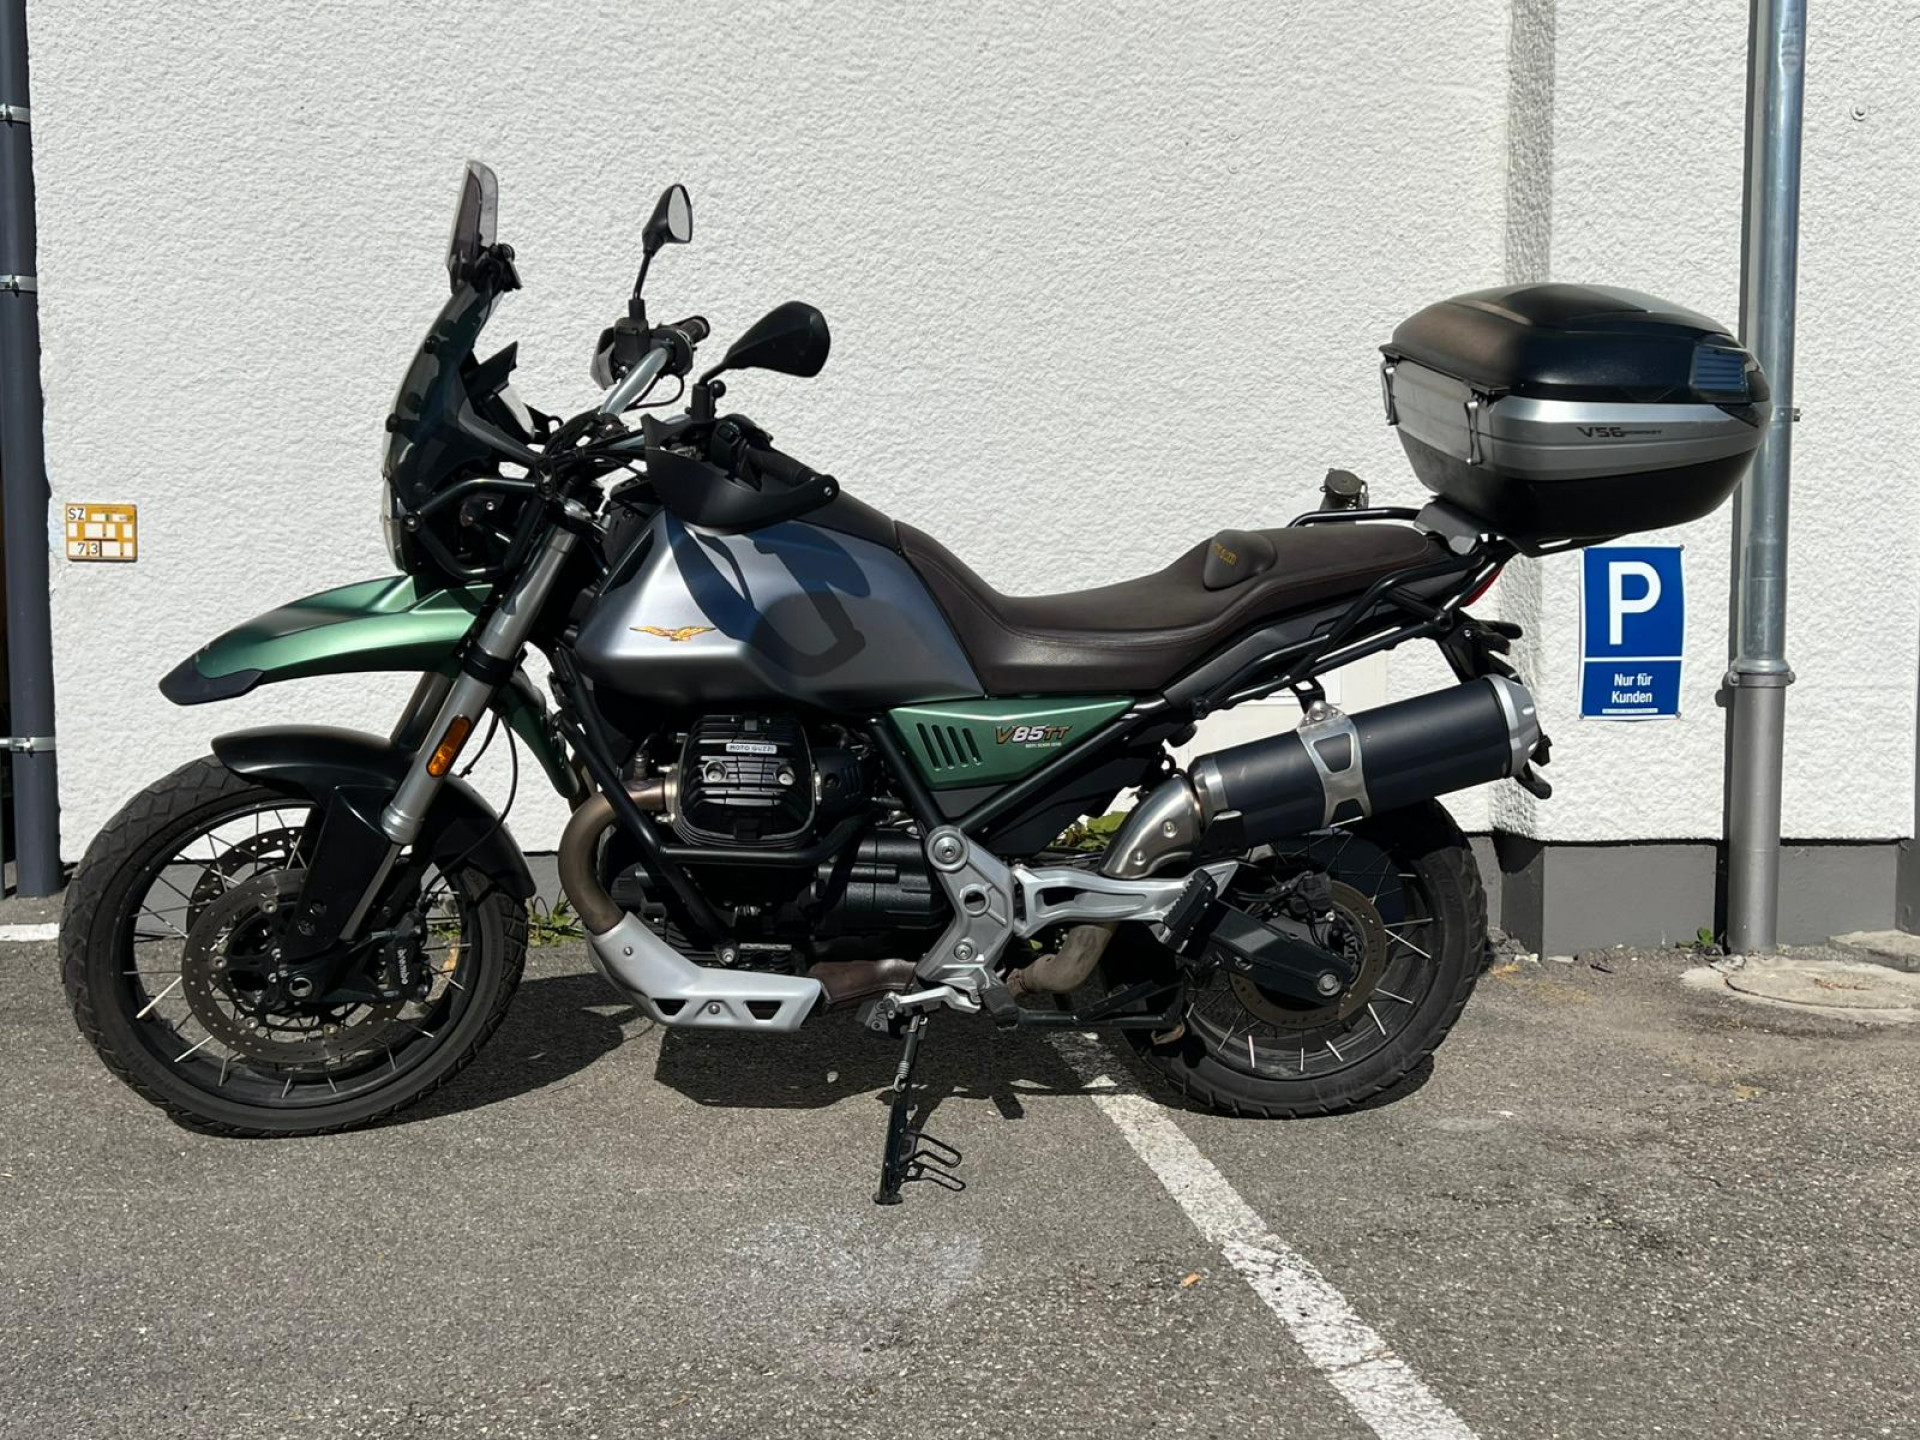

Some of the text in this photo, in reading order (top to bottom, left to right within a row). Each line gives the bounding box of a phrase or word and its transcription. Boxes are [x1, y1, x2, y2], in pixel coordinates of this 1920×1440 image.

[68, 508, 84, 520] SZ
[1609, 561, 1661, 646] P
[1614, 672, 1653, 687] Nur für
[1612, 690, 1653, 704] Kunden
